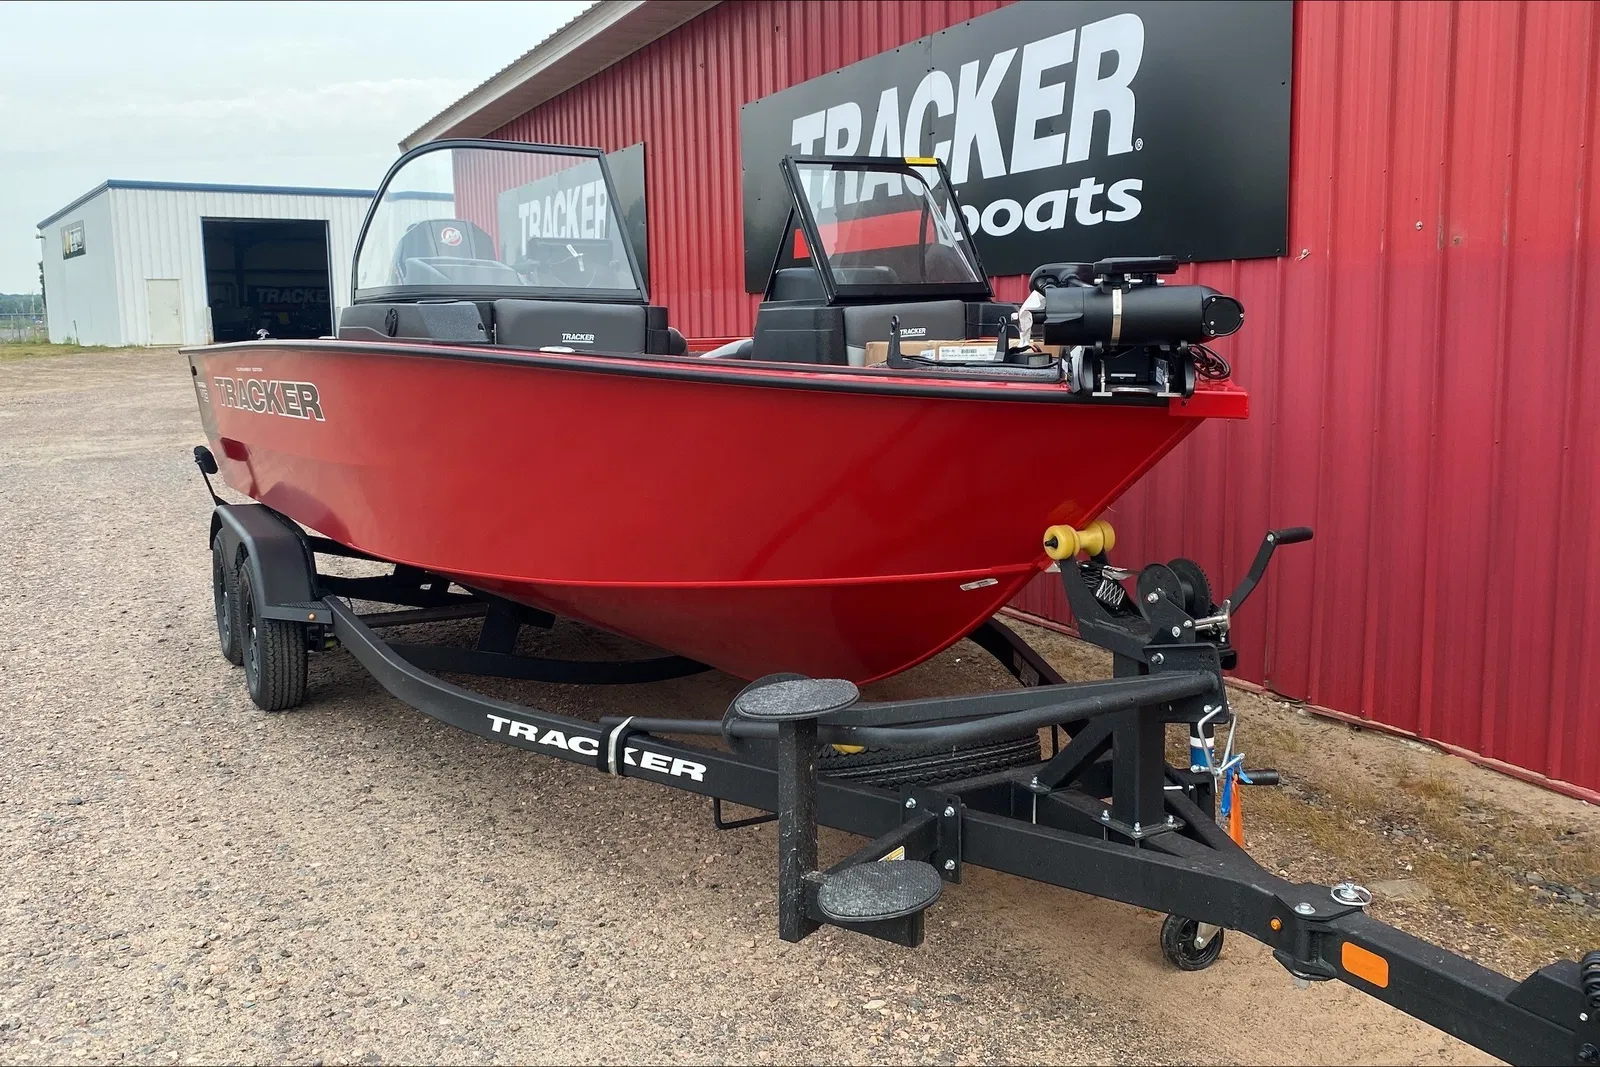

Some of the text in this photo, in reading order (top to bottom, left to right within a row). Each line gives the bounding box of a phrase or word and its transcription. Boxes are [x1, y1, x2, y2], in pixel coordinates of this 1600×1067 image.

[791, 13, 1145, 214] TRACKER
[518, 179, 608, 256] TRACKER
[944, 177, 1143, 241] boats
[562, 333, 595, 341] TRACKER
[900, 328, 926, 336] TRACKER
[213, 376, 326, 422] TRACKER
